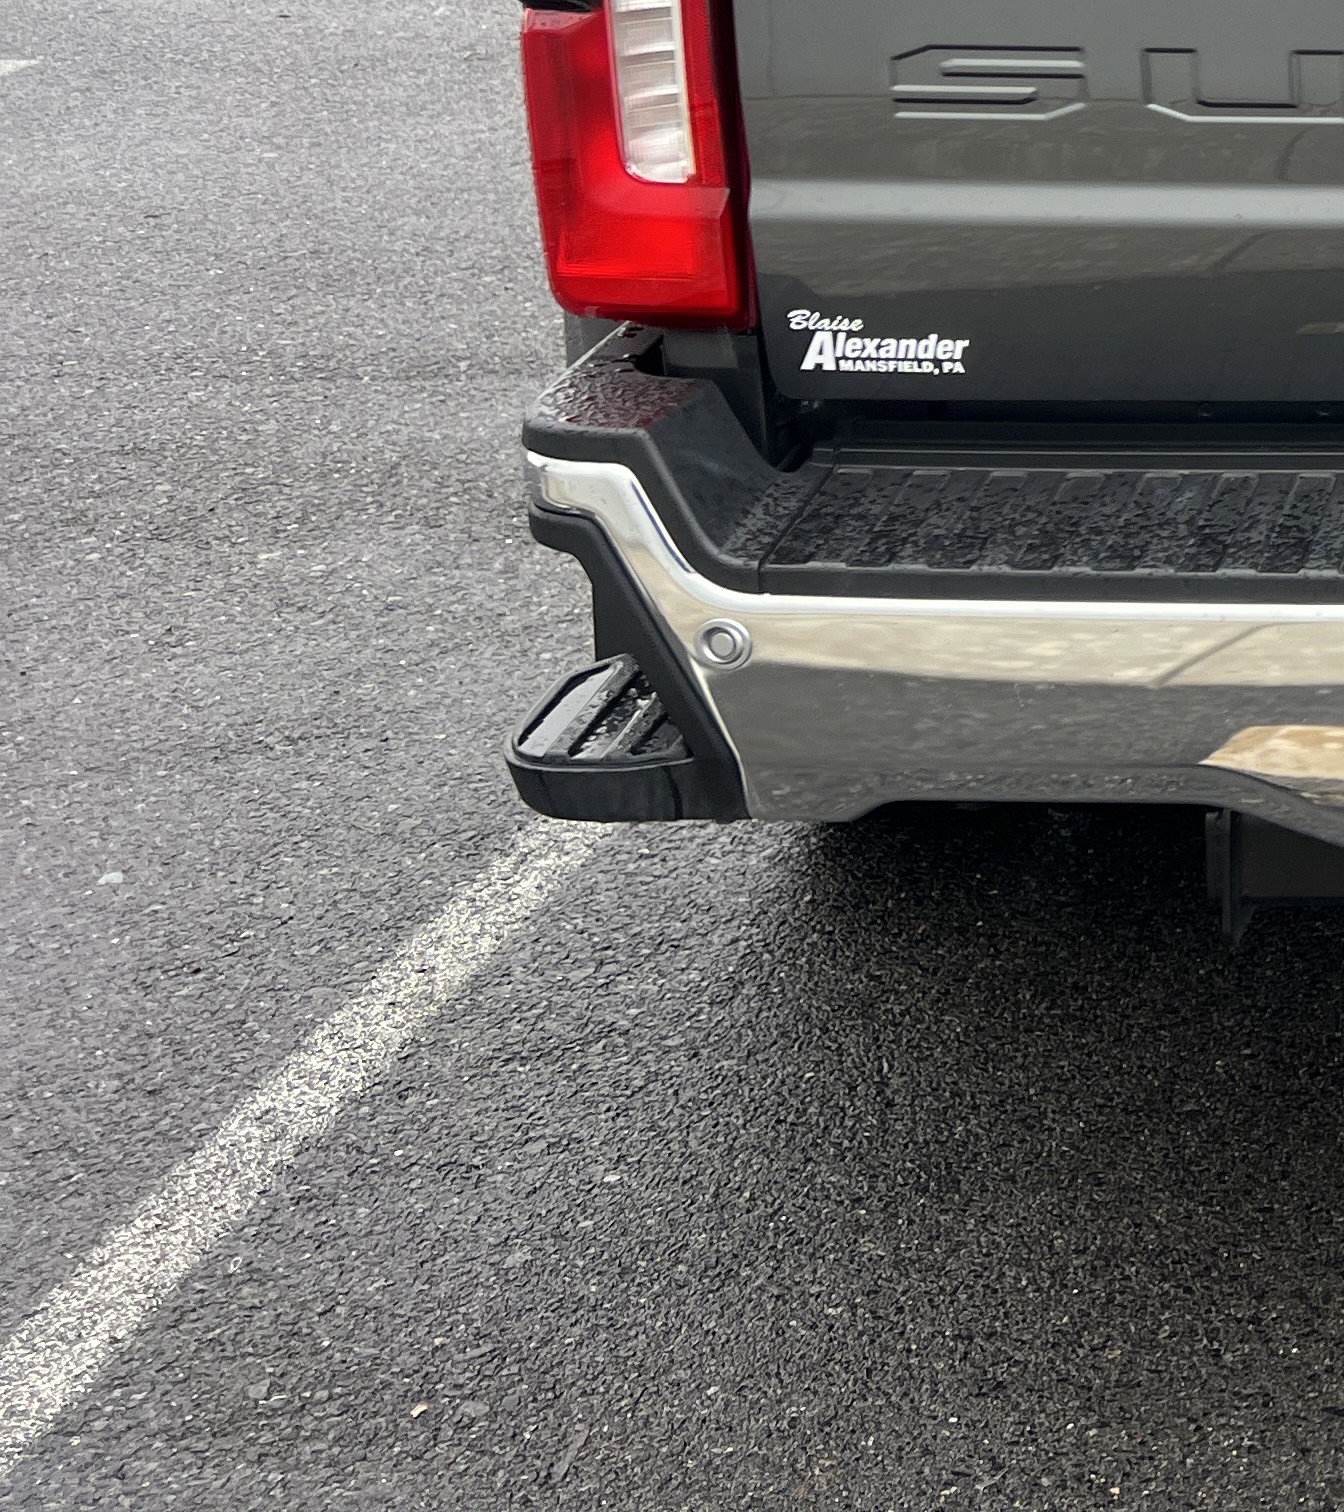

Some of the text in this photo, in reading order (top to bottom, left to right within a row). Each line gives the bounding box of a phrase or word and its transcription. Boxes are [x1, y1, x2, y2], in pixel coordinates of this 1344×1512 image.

[787, 309, 863, 331] Blaise
[800, 331, 970, 371] Alexander
[838, 360, 967, 375] MANSFIELD, PA
